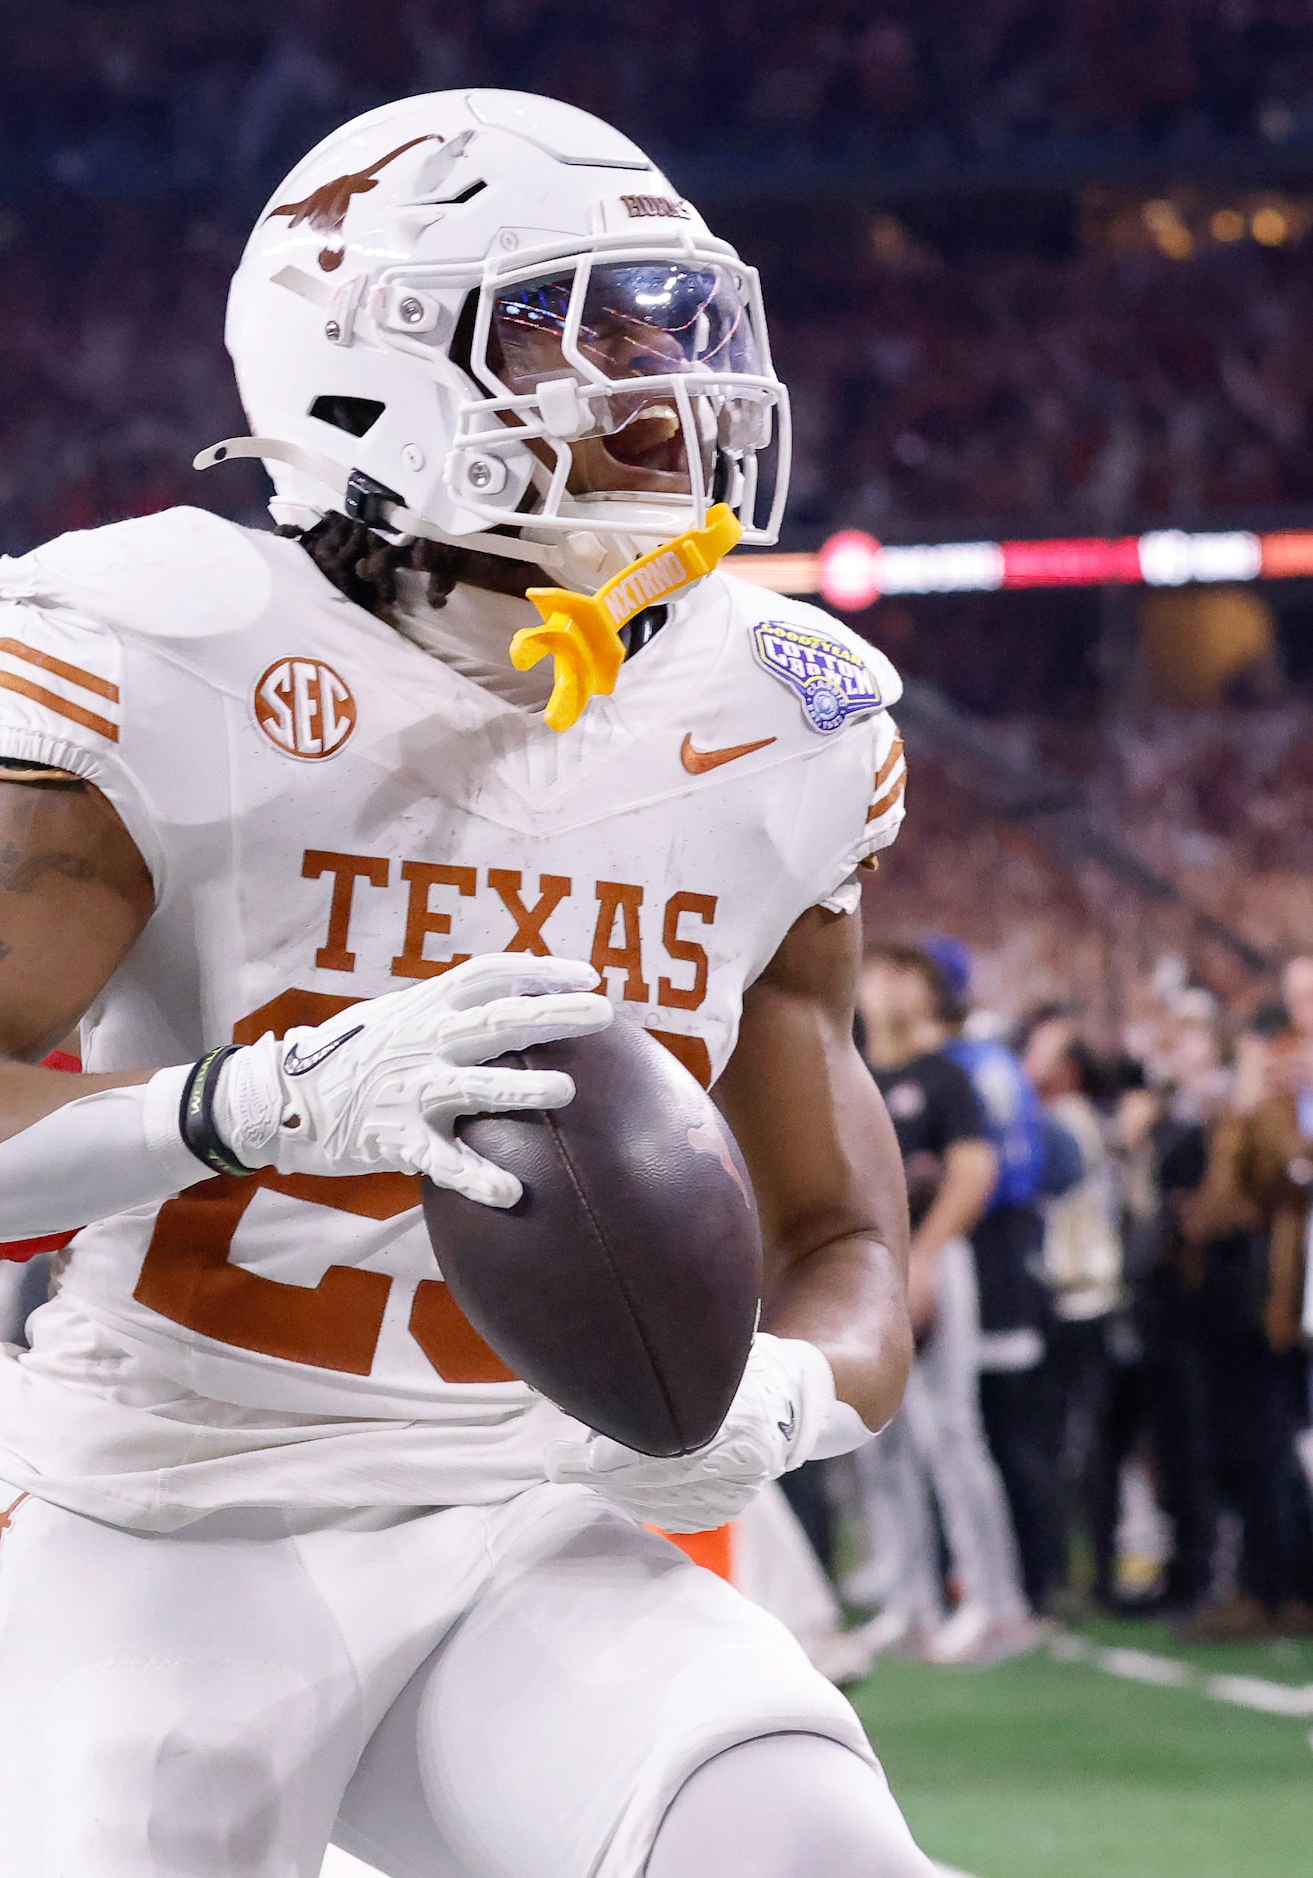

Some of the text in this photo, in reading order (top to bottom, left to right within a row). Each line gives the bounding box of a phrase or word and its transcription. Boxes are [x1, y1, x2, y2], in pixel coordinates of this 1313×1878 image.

[603, 551, 687, 625] NXTRND
[760, 622, 865, 667] GOODYEAR
[763, 634, 875, 696] COTTON
[788, 657, 859, 696] BOWL
[259, 661, 352, 754] SEC
[299, 848, 719, 1013] TEXAS
